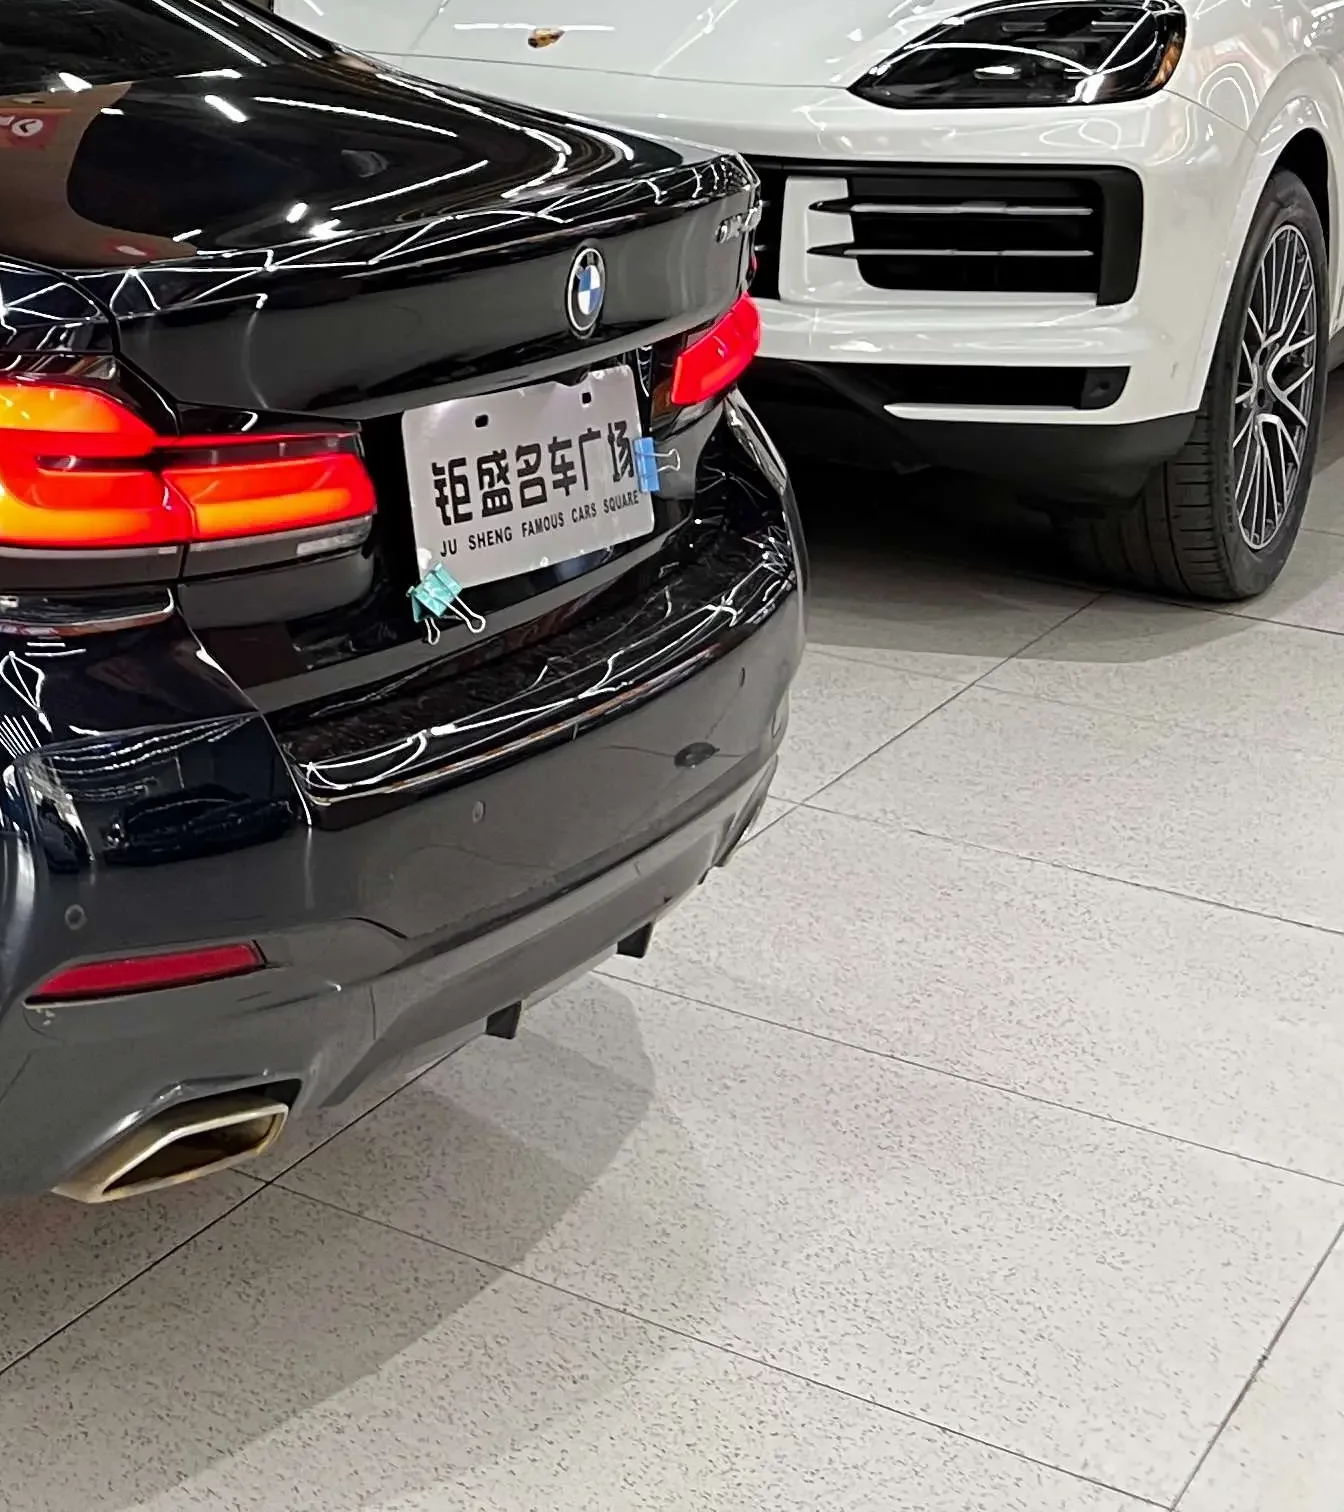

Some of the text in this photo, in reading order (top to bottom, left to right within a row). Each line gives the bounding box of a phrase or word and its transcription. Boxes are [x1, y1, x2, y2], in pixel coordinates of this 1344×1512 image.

[431, 419, 635, 526] 钜盛名车广场
[440, 489, 640, 557] JU SHENG FAMOUS CARS SQUARE
